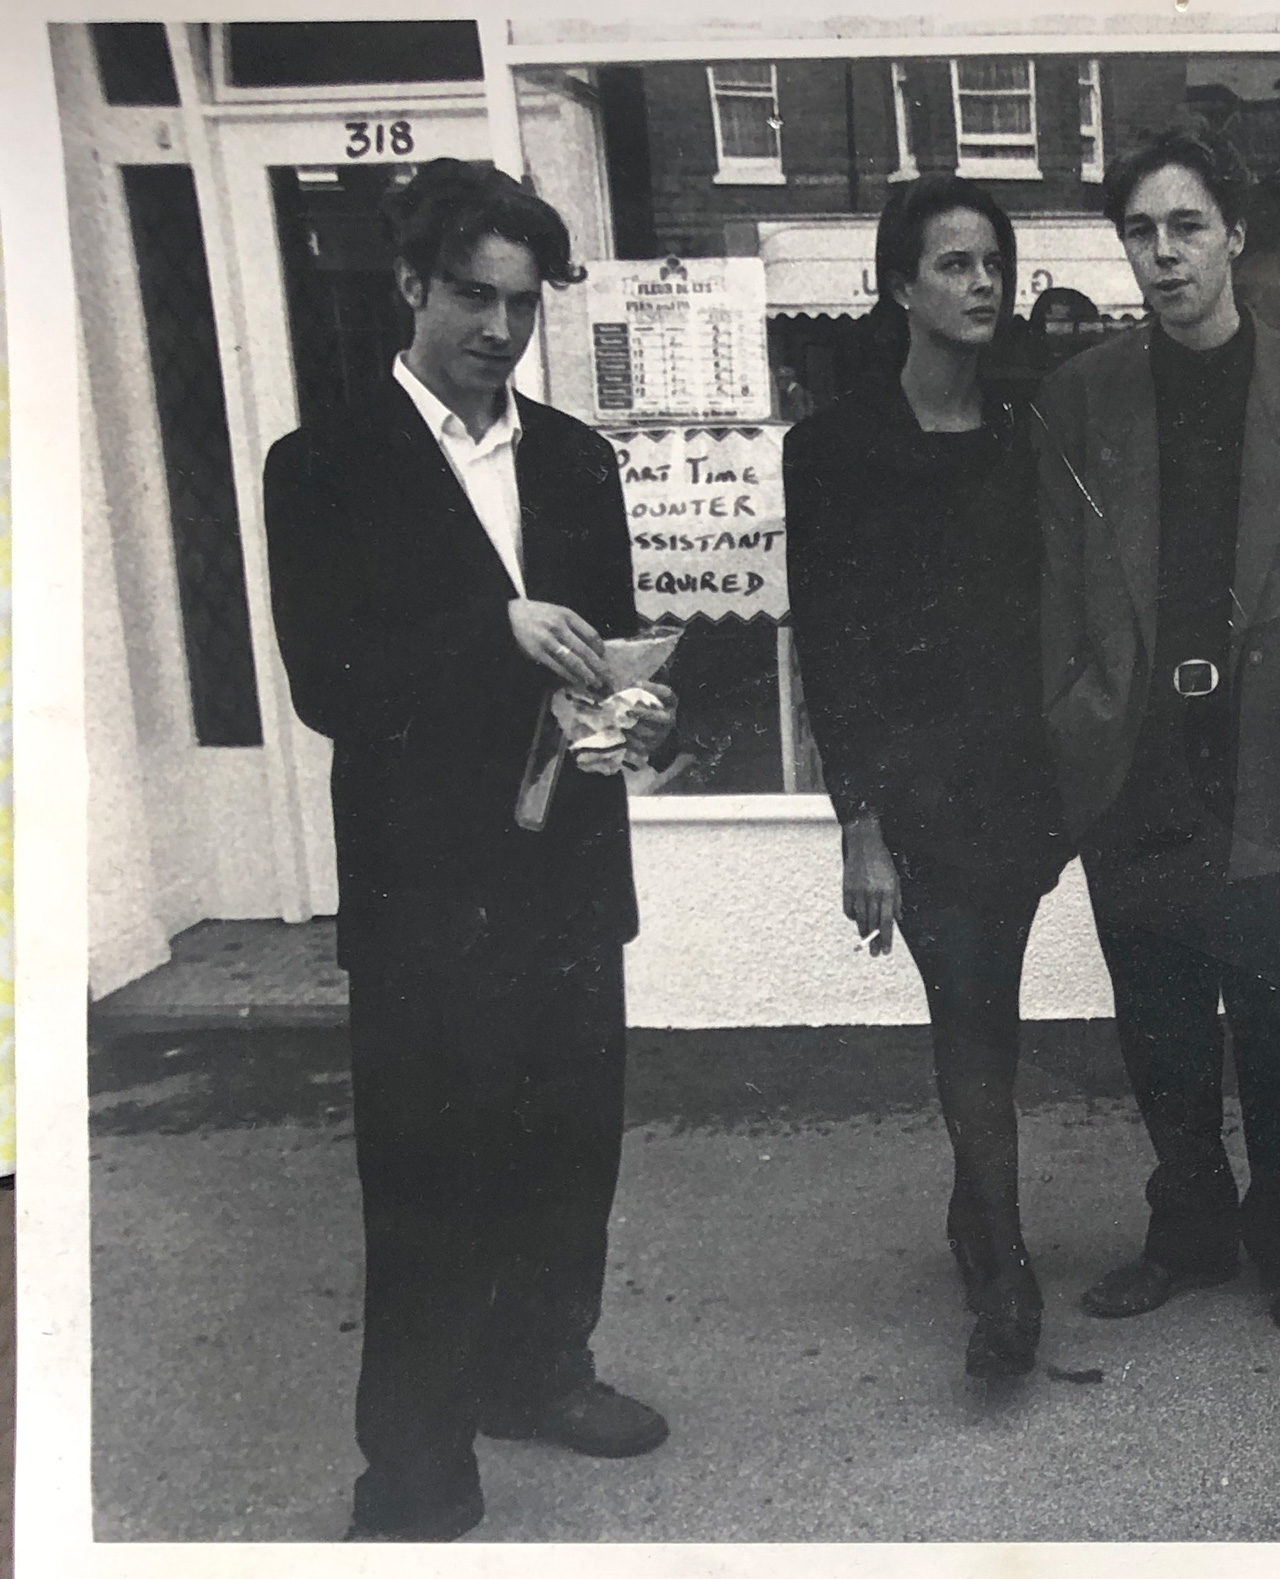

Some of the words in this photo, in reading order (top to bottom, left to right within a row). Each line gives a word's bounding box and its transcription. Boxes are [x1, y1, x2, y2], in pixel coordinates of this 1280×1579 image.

[345, 120, 414, 158] 318
[628, 495, 756, 518] OUNTER
[631, 531, 786, 552] SSISTANT
[636, 571, 765, 596] EQUIRED
